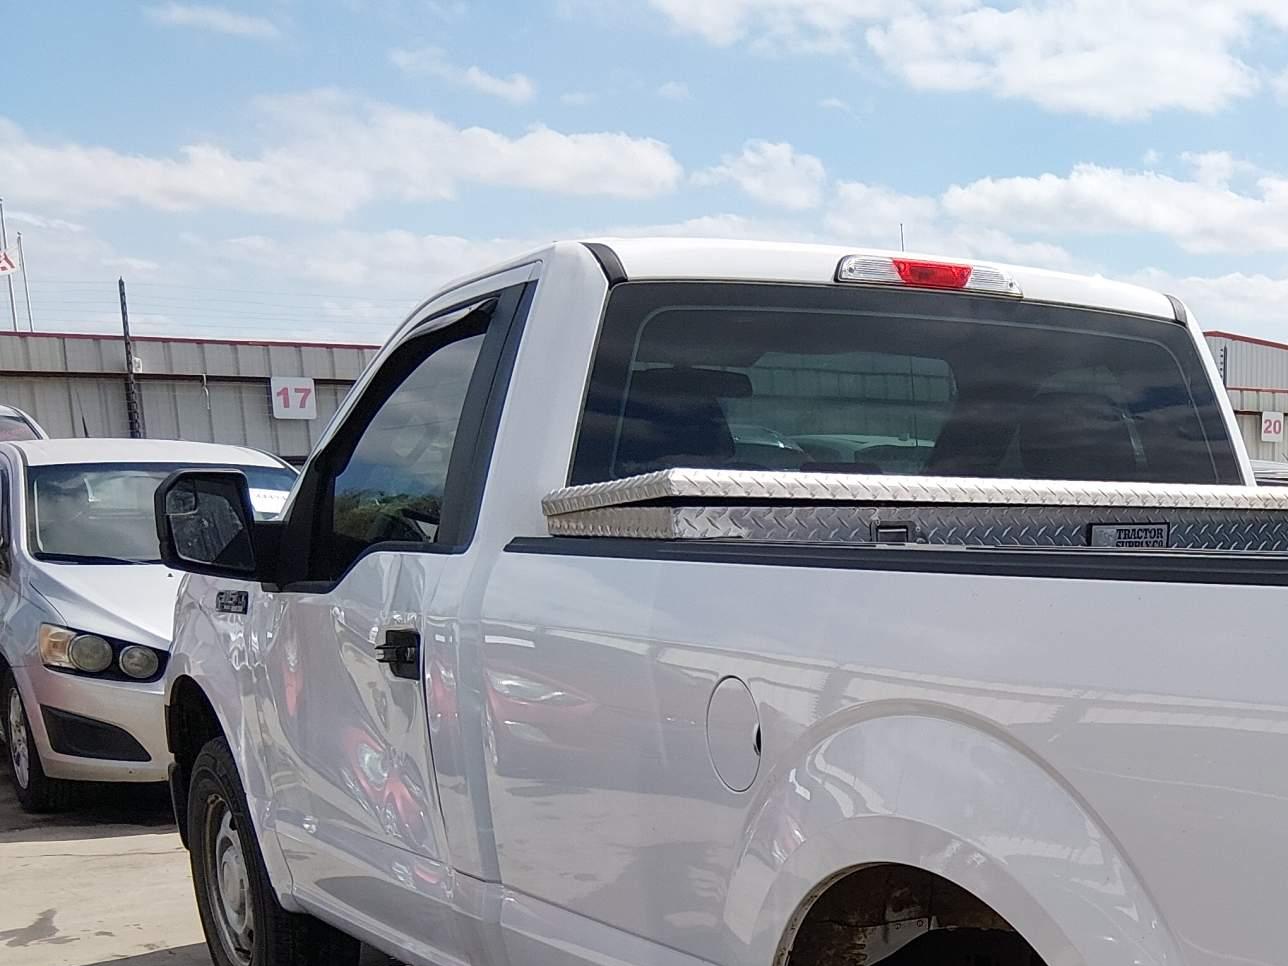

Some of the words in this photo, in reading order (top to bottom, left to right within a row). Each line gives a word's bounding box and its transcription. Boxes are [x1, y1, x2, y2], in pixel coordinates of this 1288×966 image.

[276, 386, 312, 409] 17
[1263, 418, 1282, 434] 20
[1116, 528, 1164, 540] TRACTOR
